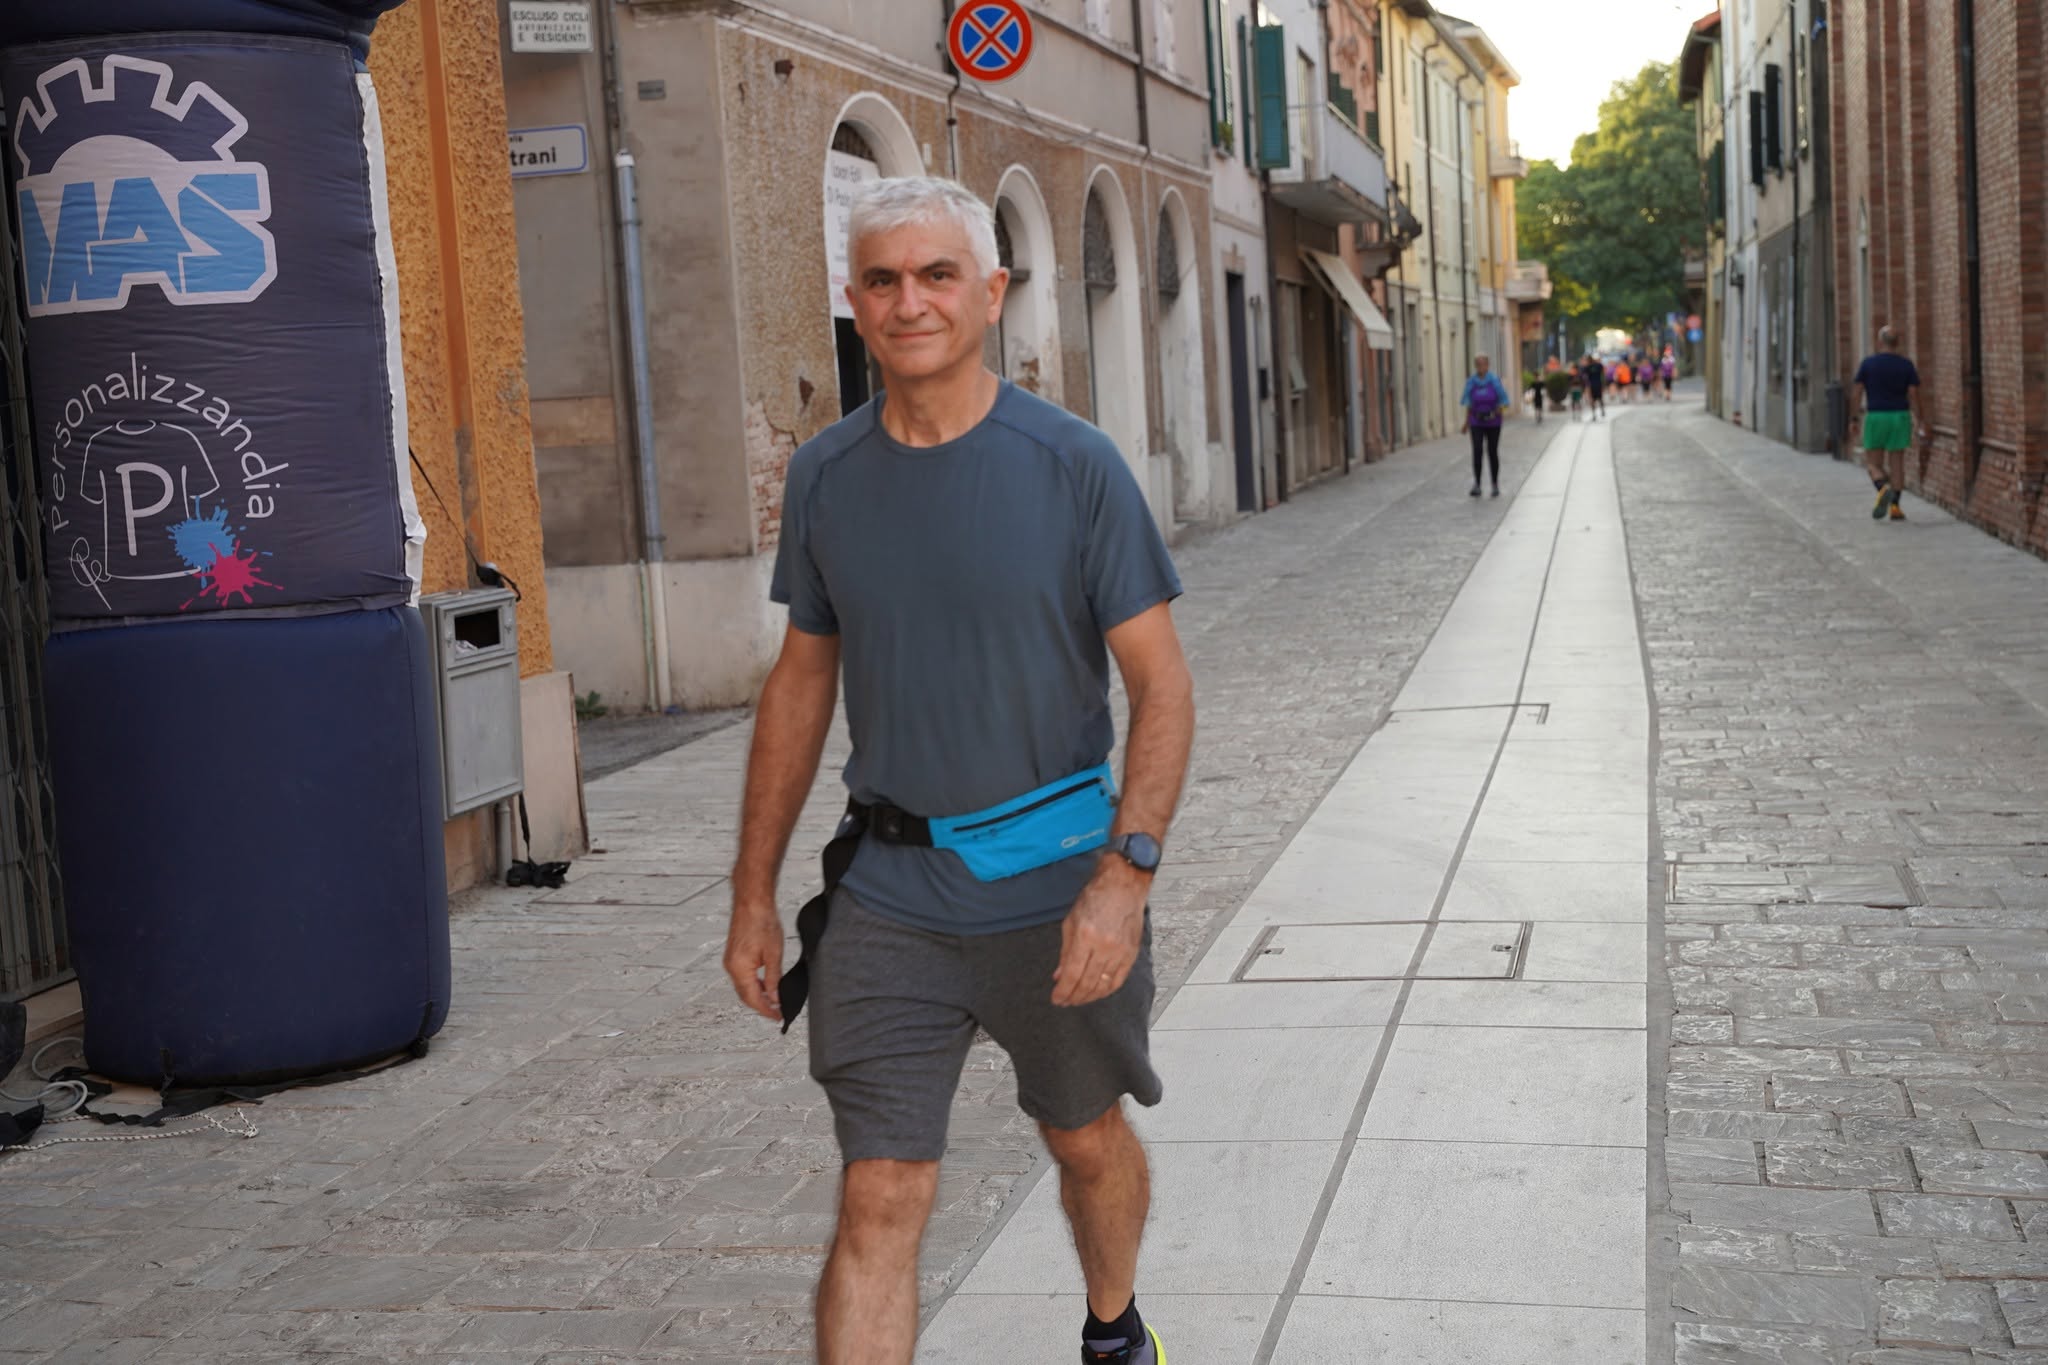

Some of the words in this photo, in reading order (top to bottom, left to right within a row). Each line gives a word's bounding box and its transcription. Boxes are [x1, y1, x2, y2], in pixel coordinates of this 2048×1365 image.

[512, 10, 559, 21] ESCLUSO
[533, 32, 587, 43] RESIDENTI
[51, 352, 289, 535] Personalizzandia
[115, 461, 175, 557] P
